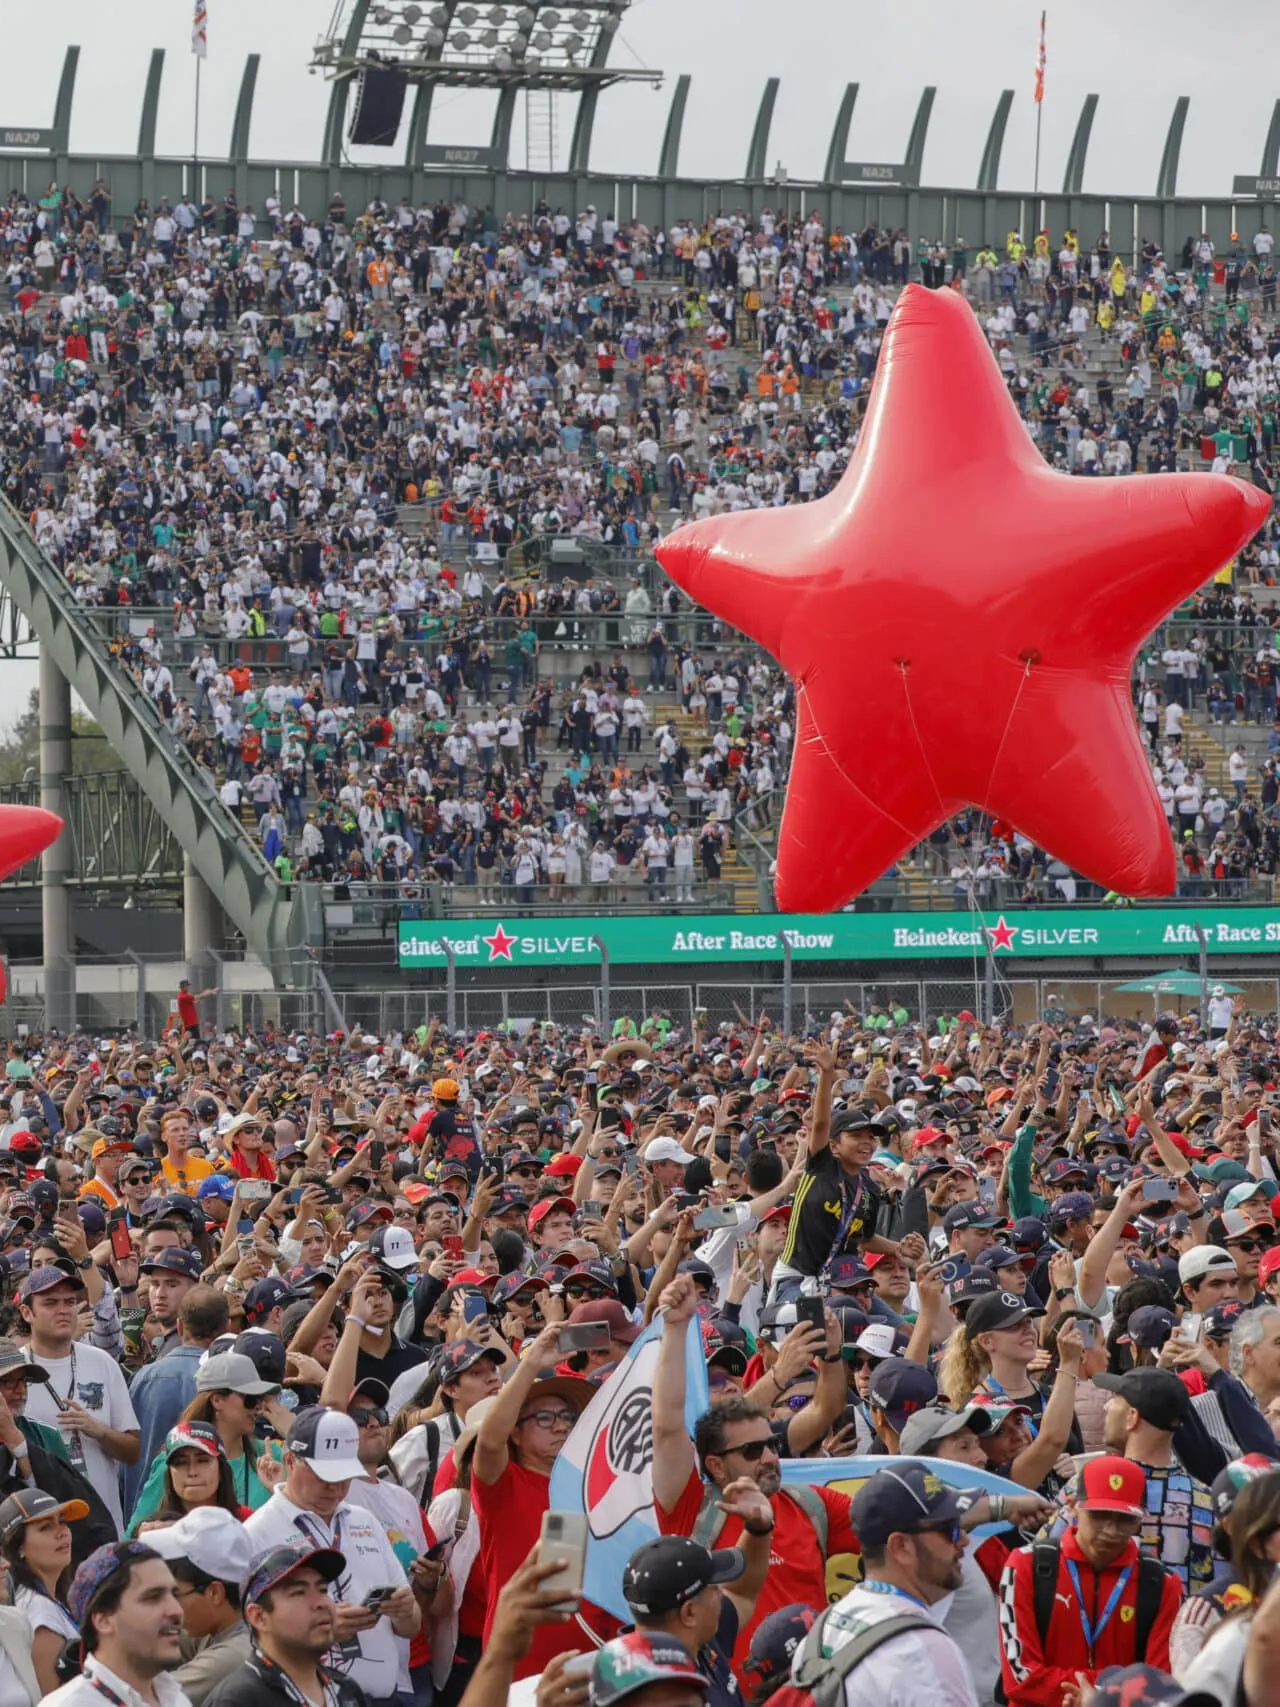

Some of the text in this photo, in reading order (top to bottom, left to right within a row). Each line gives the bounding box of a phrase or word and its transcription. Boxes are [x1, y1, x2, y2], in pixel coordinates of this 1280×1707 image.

[4, 132, 40, 144] NA29
[861, 166, 893, 178] NA25
[672, 929, 834, 951] After Race Show
[893, 927, 1099, 947] Heineken SILVER
[1216, 923, 1261, 942] Race
[520, 936, 601, 954] SILVER
[324, 1438, 339, 1450] 11
